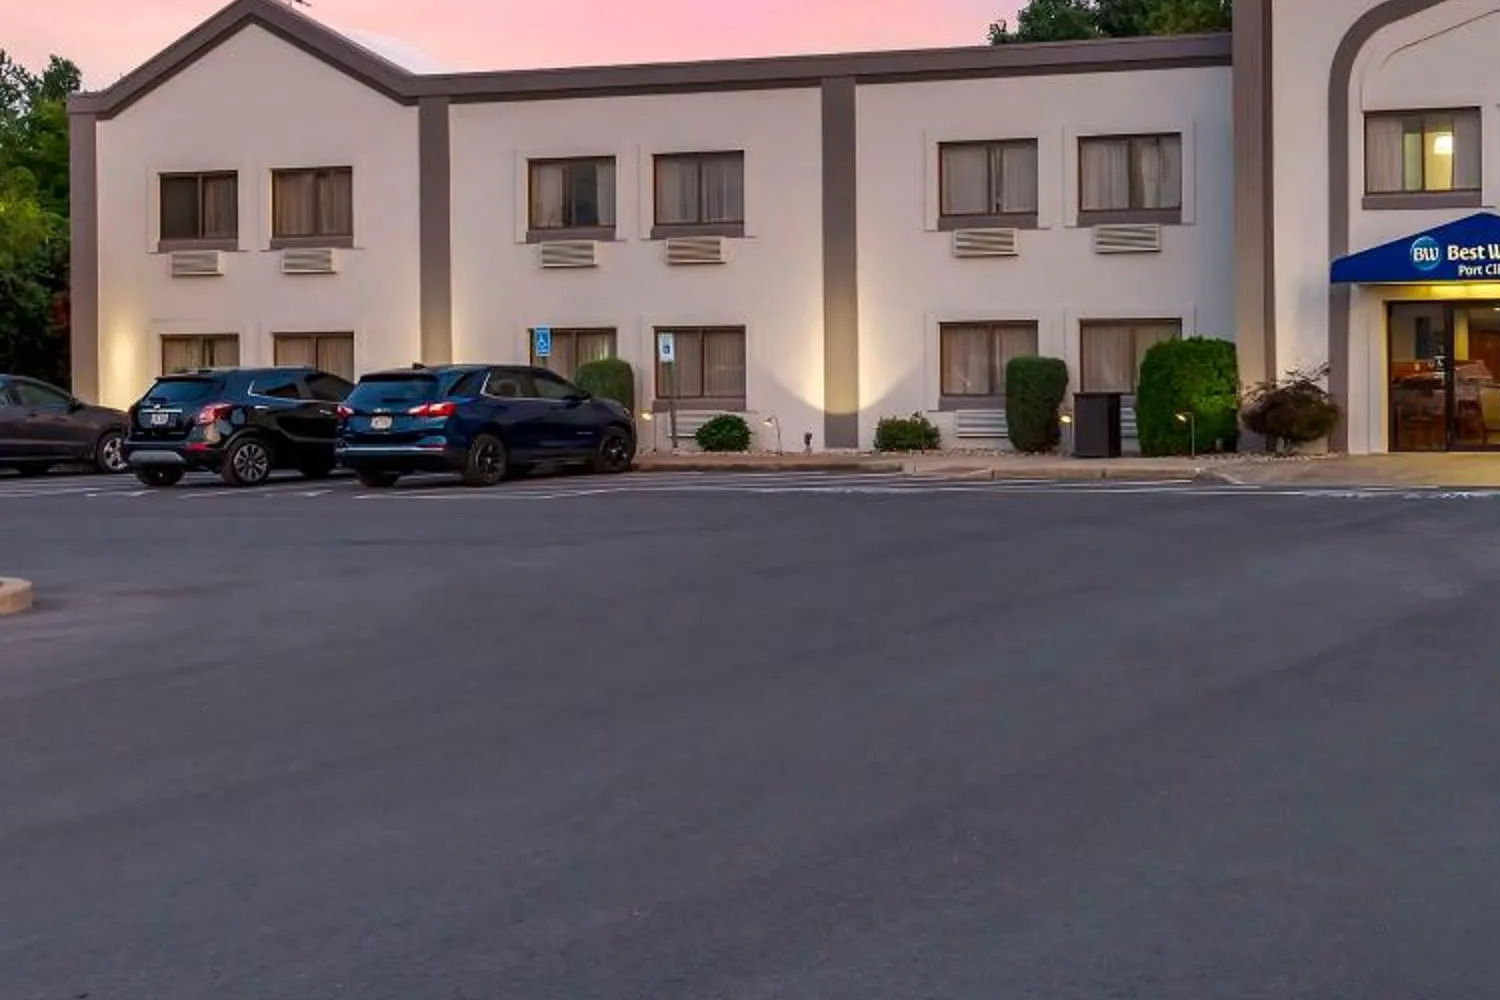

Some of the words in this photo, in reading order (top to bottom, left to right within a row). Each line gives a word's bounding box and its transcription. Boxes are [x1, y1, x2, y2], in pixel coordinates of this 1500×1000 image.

[1413, 247, 1439, 262] BW
[1447, 244, 1486, 261] Best
[1458, 264, 1483, 276] Port
